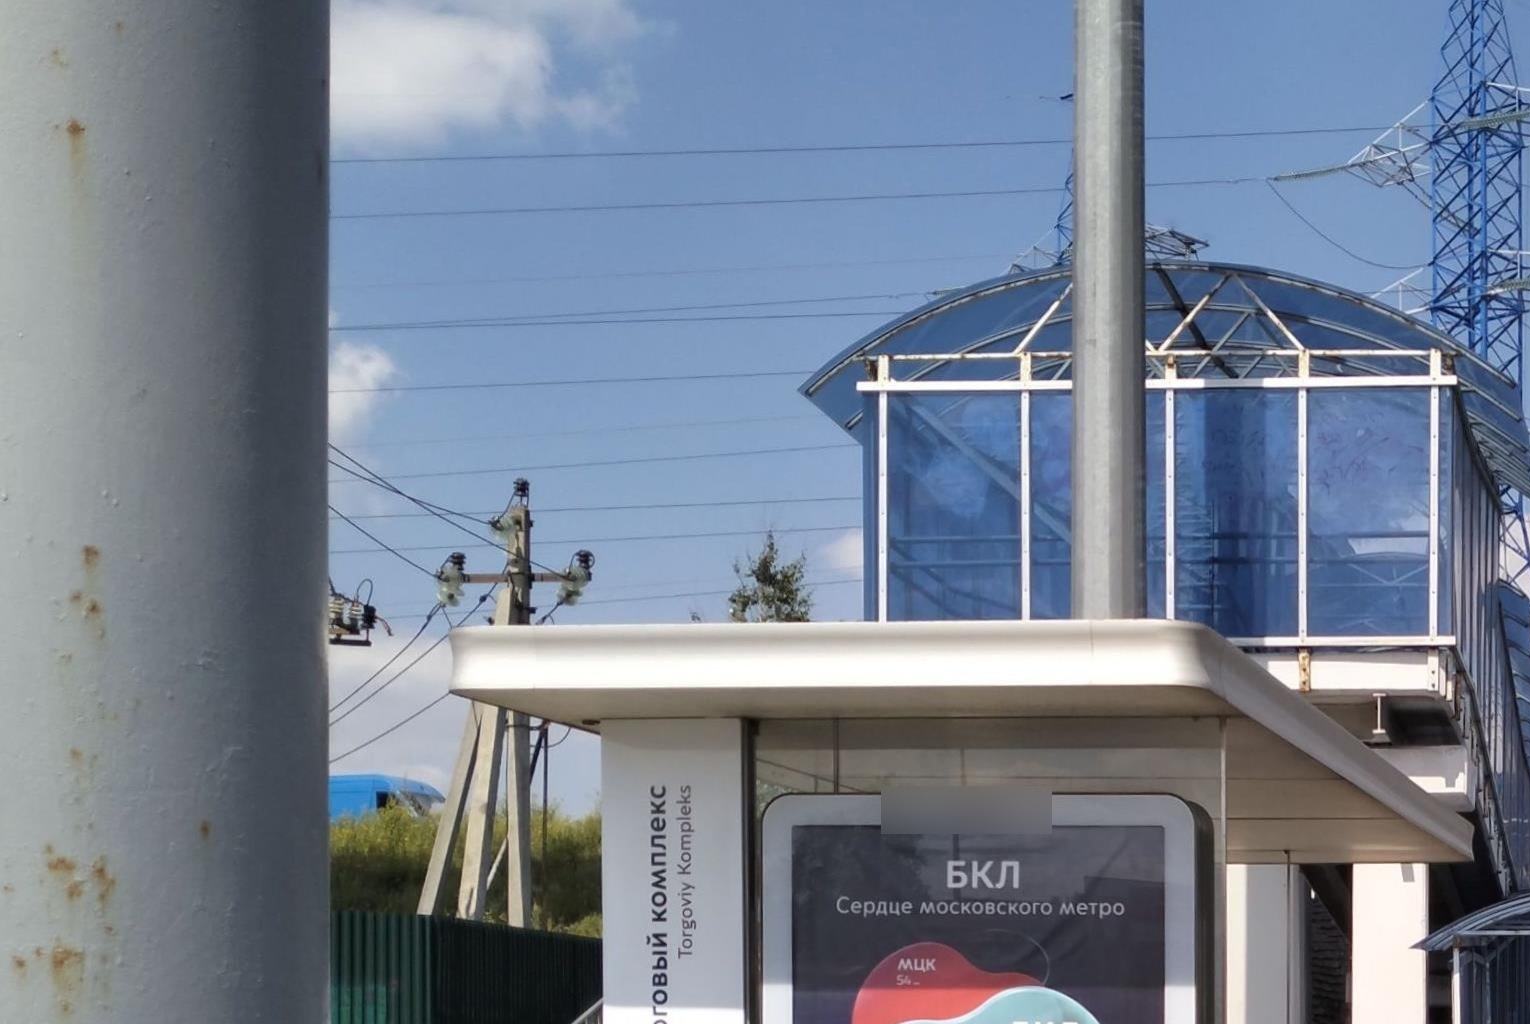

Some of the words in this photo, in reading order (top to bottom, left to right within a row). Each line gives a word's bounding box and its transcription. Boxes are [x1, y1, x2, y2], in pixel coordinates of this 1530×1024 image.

[650, 784, 669, 922] комплекс
[676, 784, 695, 876] Kompleks
[946, 861, 1020, 889] БКЛ
[676, 881, 697, 959] Torgoviy
[835, 896, 913, 917] Сердце
[920, 900, 1053, 916] московского
[1059, 901, 1126, 919] метро
[897, 957, 937, 973] МЦК
